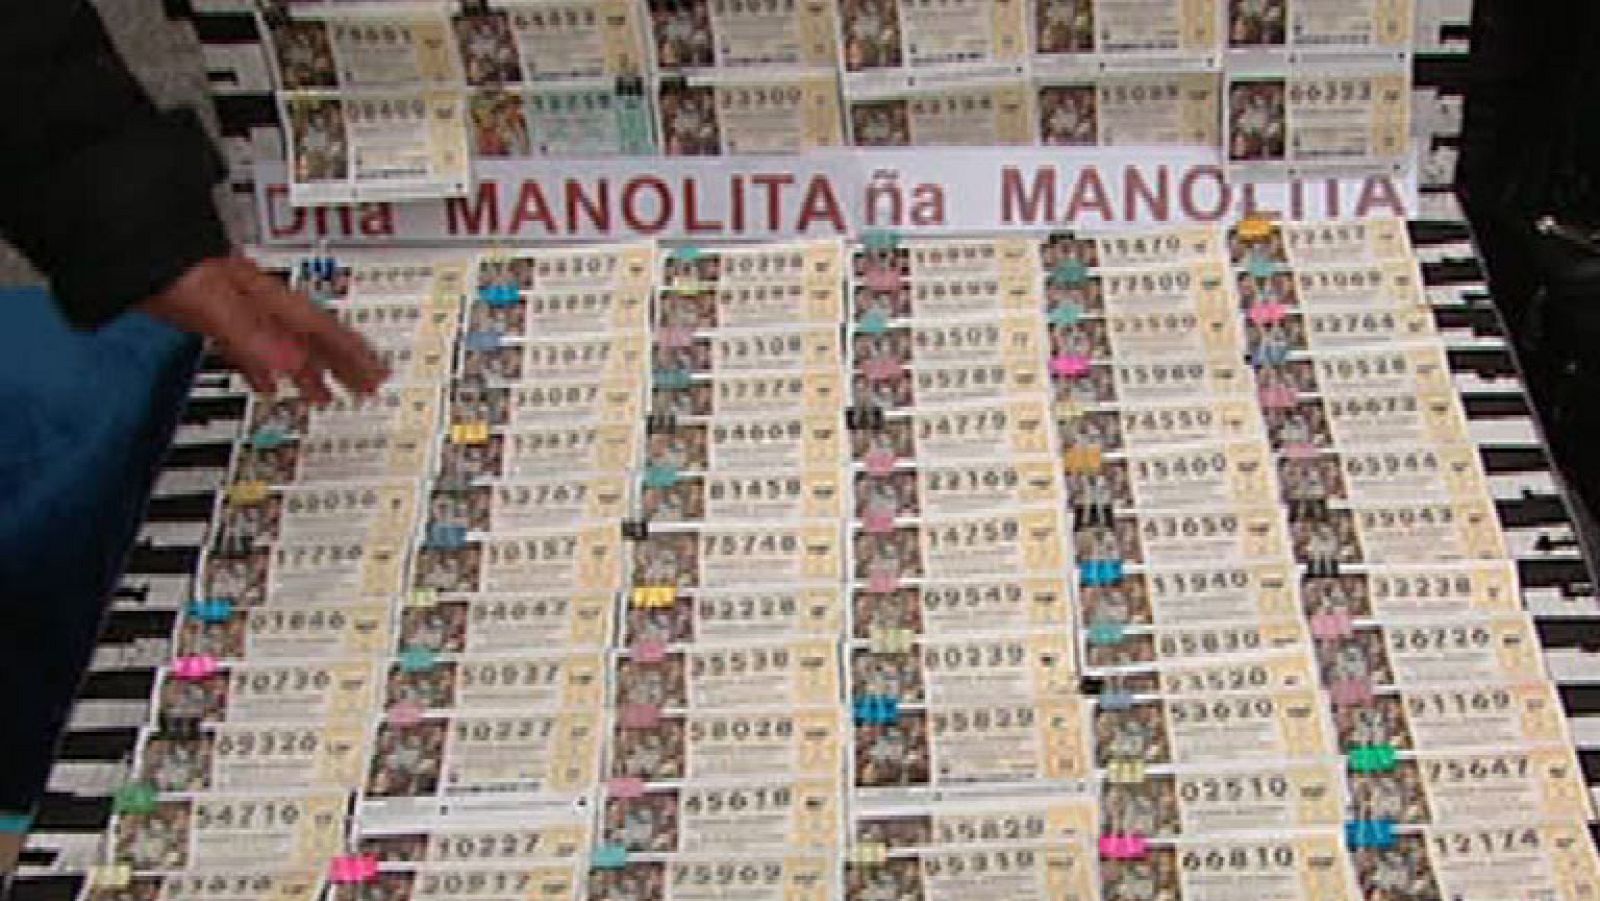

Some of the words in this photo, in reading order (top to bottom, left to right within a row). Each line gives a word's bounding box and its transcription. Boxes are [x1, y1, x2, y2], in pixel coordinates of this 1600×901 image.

[447, 175, 847, 234] MANOLITA
[863, 167, 945, 226] ña
[1183, 848, 1293, 870] 66810
